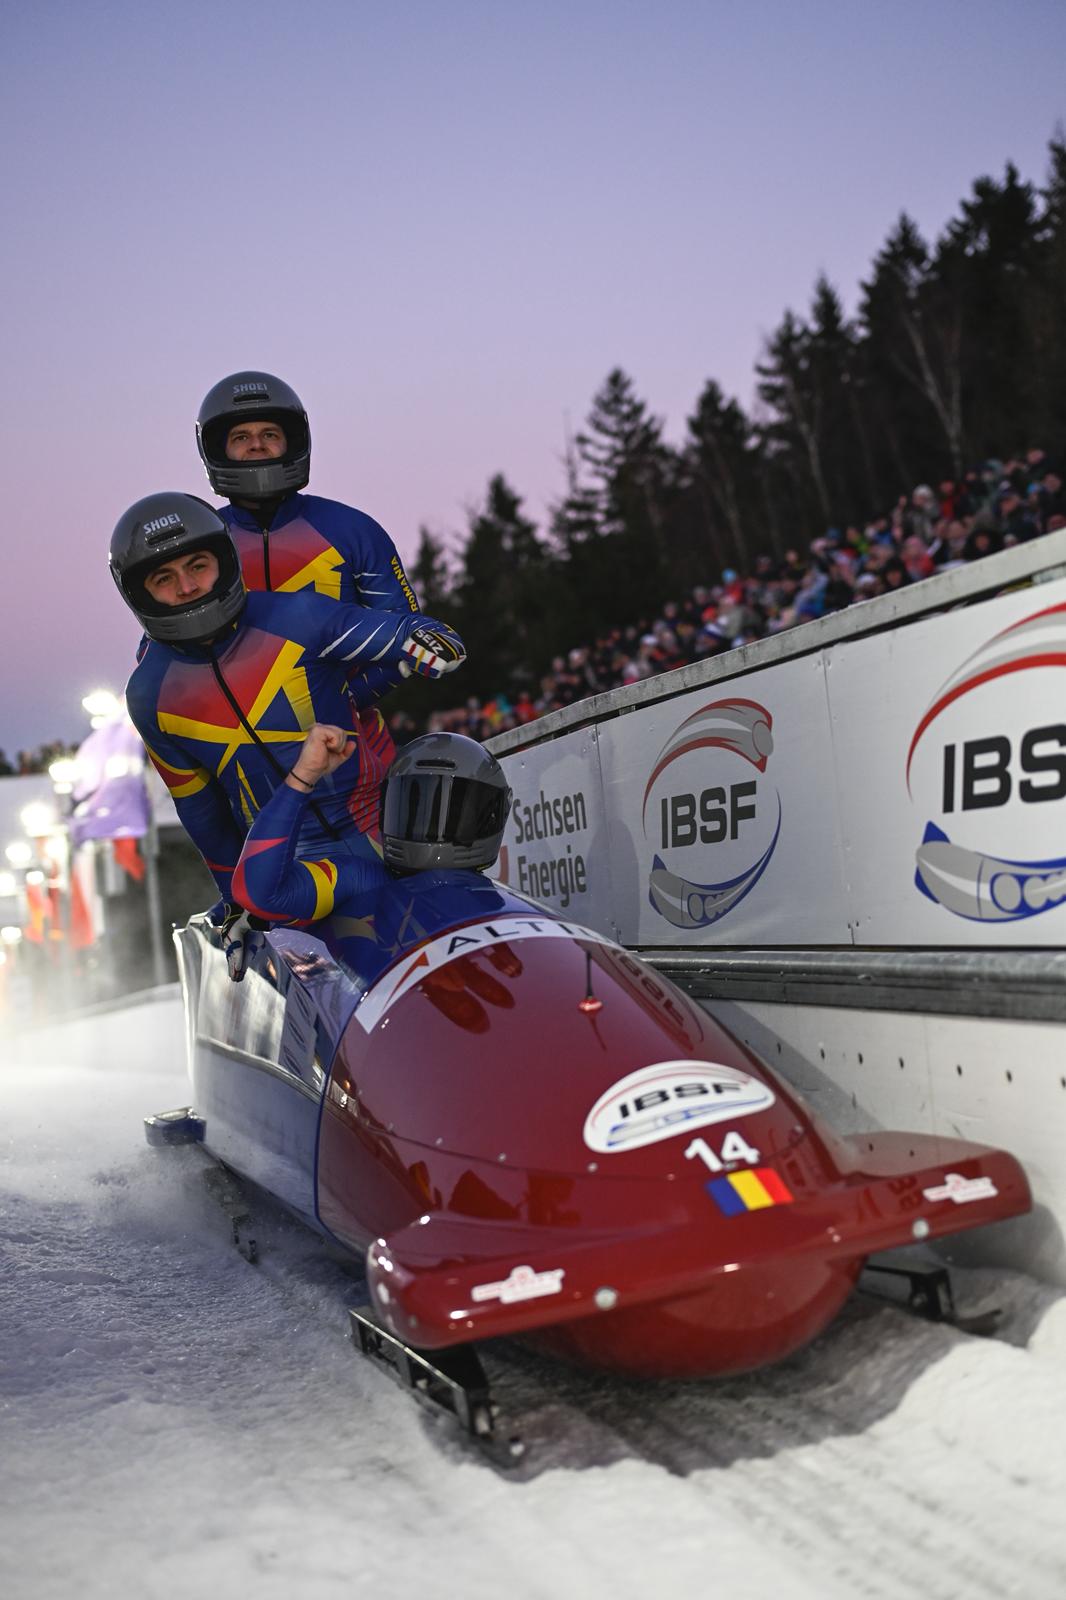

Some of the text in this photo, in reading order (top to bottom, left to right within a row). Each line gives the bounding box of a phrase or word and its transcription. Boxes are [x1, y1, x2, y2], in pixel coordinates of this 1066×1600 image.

[232, 382, 268, 394] SHOEI
[143, 513, 181, 534] SHOEI
[391, 556, 419, 612] ROMANIA
[415, 629, 445, 655] SEIZ
[512, 790, 588, 845] Sachsen
[661, 780, 757, 849] IBSF
[517, 845, 588, 908] Energie
[618, 1082, 742, 1119] IBSF
[684, 1131, 760, 1173] 14
